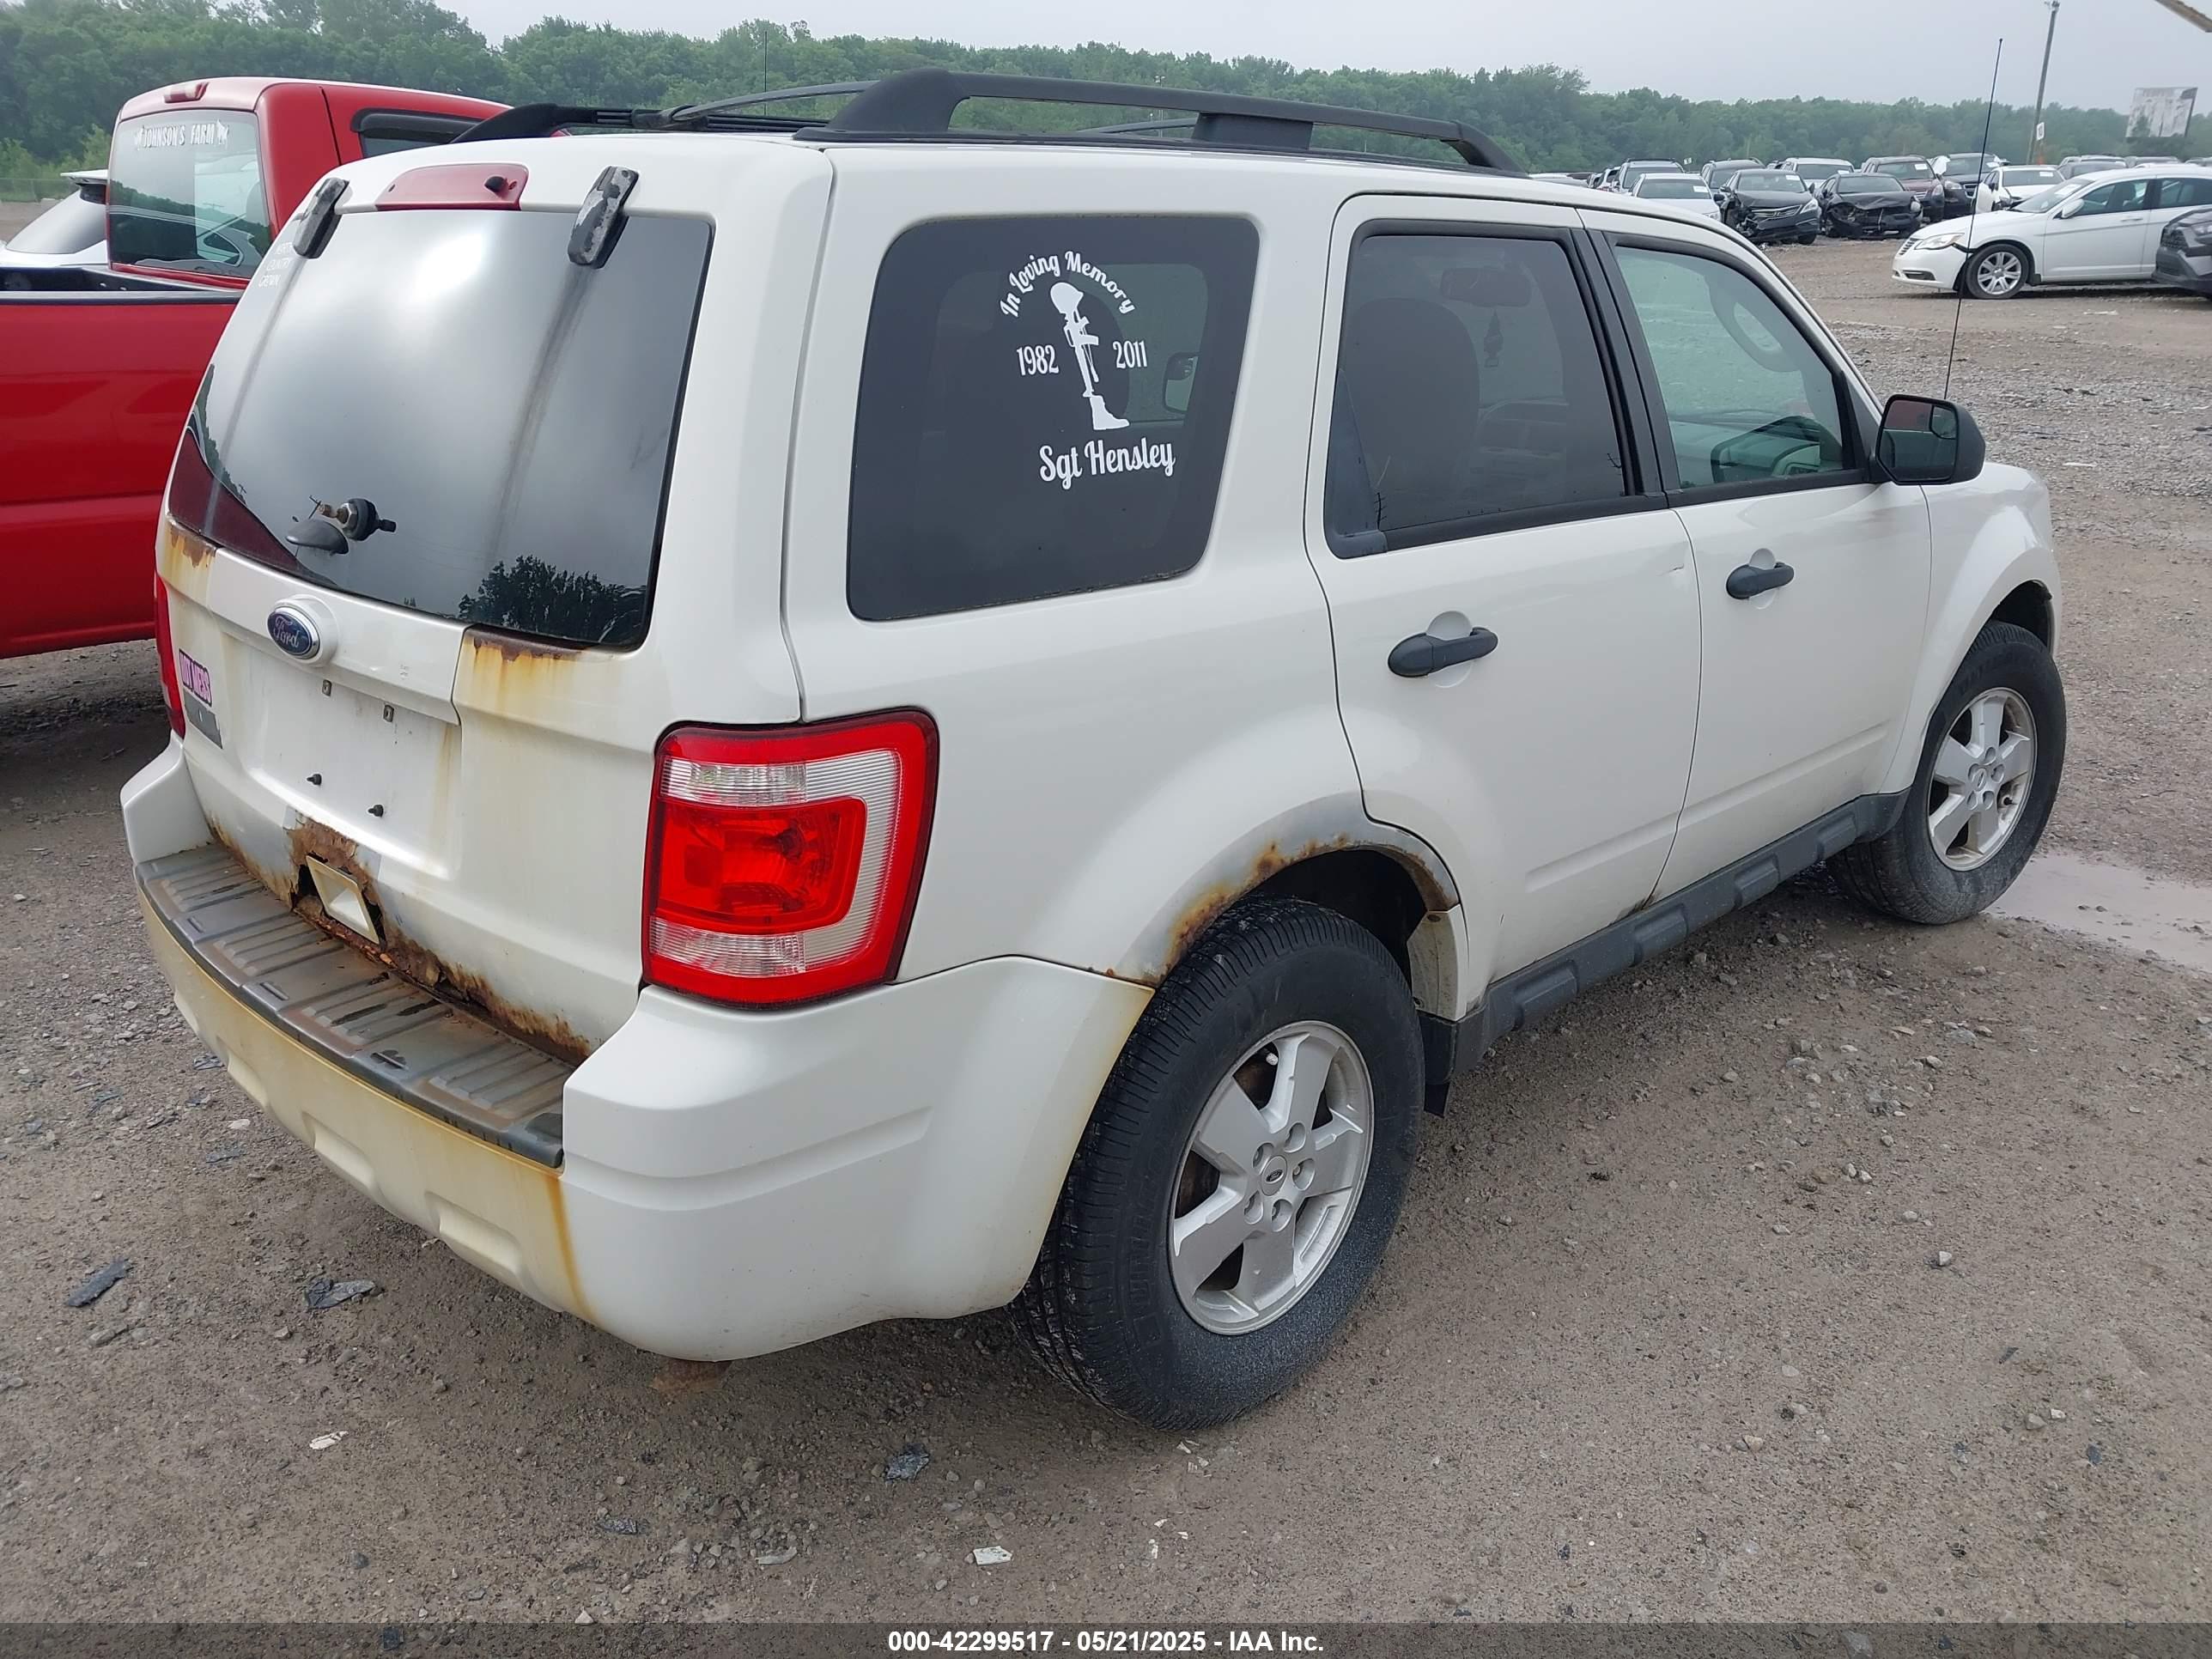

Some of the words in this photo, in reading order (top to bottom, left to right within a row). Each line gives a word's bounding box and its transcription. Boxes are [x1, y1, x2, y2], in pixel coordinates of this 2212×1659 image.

[143, 125, 185, 148] JOHNSON'S
[191, 123, 216, 144] FARM
[1008, 254, 1060, 294] Loving
[1064, 251, 1135, 314] Memory
[1000, 293, 1020, 318] In
[1017, 344, 1060, 375] 1982
[1112, 340, 1147, 369] 2011
[1039, 445, 1083, 490] Sgt
[1084, 436, 1176, 477] Hensley
[273, 615, 301, 648] Ford
